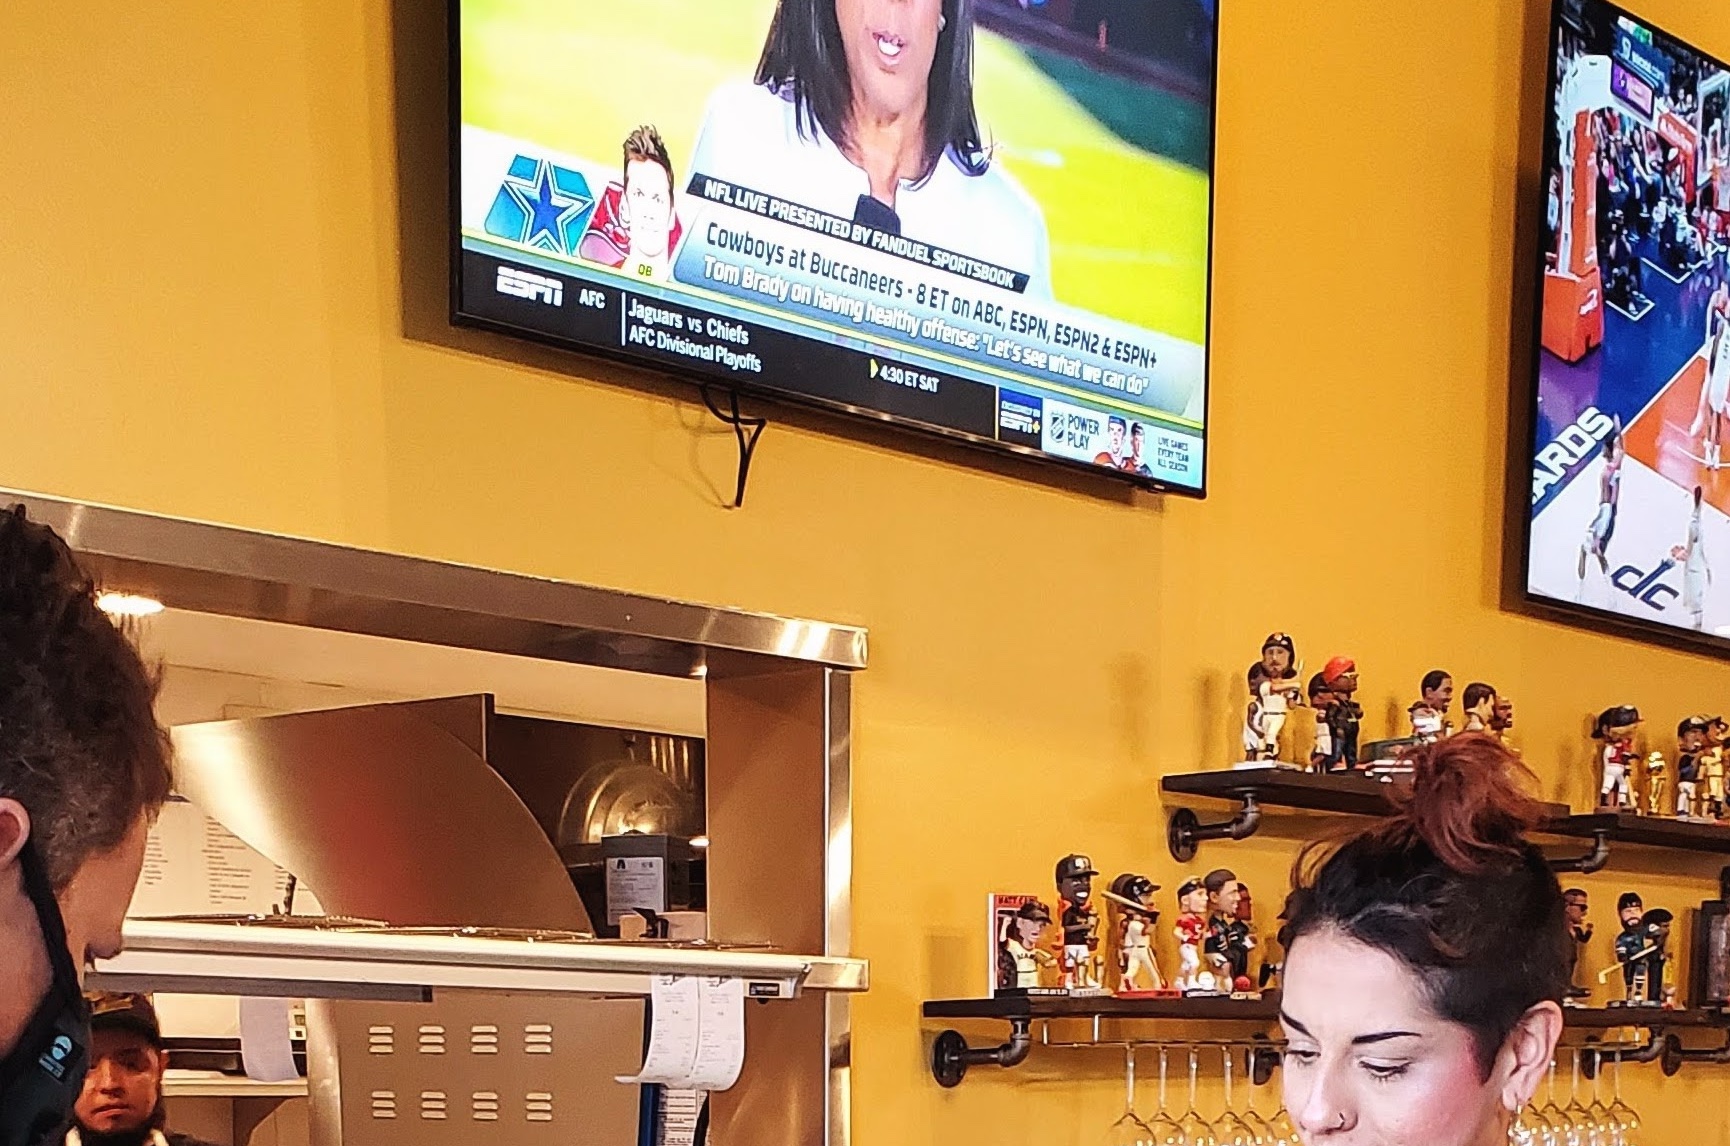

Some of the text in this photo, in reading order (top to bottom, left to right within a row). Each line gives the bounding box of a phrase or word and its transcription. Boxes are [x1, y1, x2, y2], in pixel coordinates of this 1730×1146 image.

[704, 179, 1016, 290] NFL LIVE PRESENTED BY FANDUEL SPORTSBOOK
[496, 265, 563, 307] ESPN
[579, 288, 606, 309] AFC
[706, 221, 785, 267] Cowboys
[788, 249, 806, 271] at
[810, 252, 903, 299] Buccaneers
[916, 282, 926, 305] 8
[930, 286, 949, 312] ET
[952, 296, 970, 319] on
[973, 300, 1006, 332] ABC,
[1009, 310, 1051, 345] ESPN,
[1054, 322, 1100, 356] ESPN2
[1101, 337, 1112, 358] &
[1113, 340, 1157, 369] ESPN+
[628, 299, 750, 346] Jaguars vs Chiefs
[704, 254, 740, 285] Tom
[741, 265, 791, 301] Brady
[791, 282, 812, 303] on
[814, 285, 865, 323] having
[865, 300, 921, 338] healthy
[922, 317, 981, 351] offense:
[1022, 347, 1048, 369] see
[1048, 352, 1082, 380] what
[1082, 363, 1101, 384] we
[1102, 369, 1126, 391] can
[629, 328, 763, 373] AFC Divisional Playoffs
[879, 364, 940, 394] 4:30 ET SAT
[1067, 413, 1100, 437] POWER
[1067, 432, 1091, 451] PLAY
